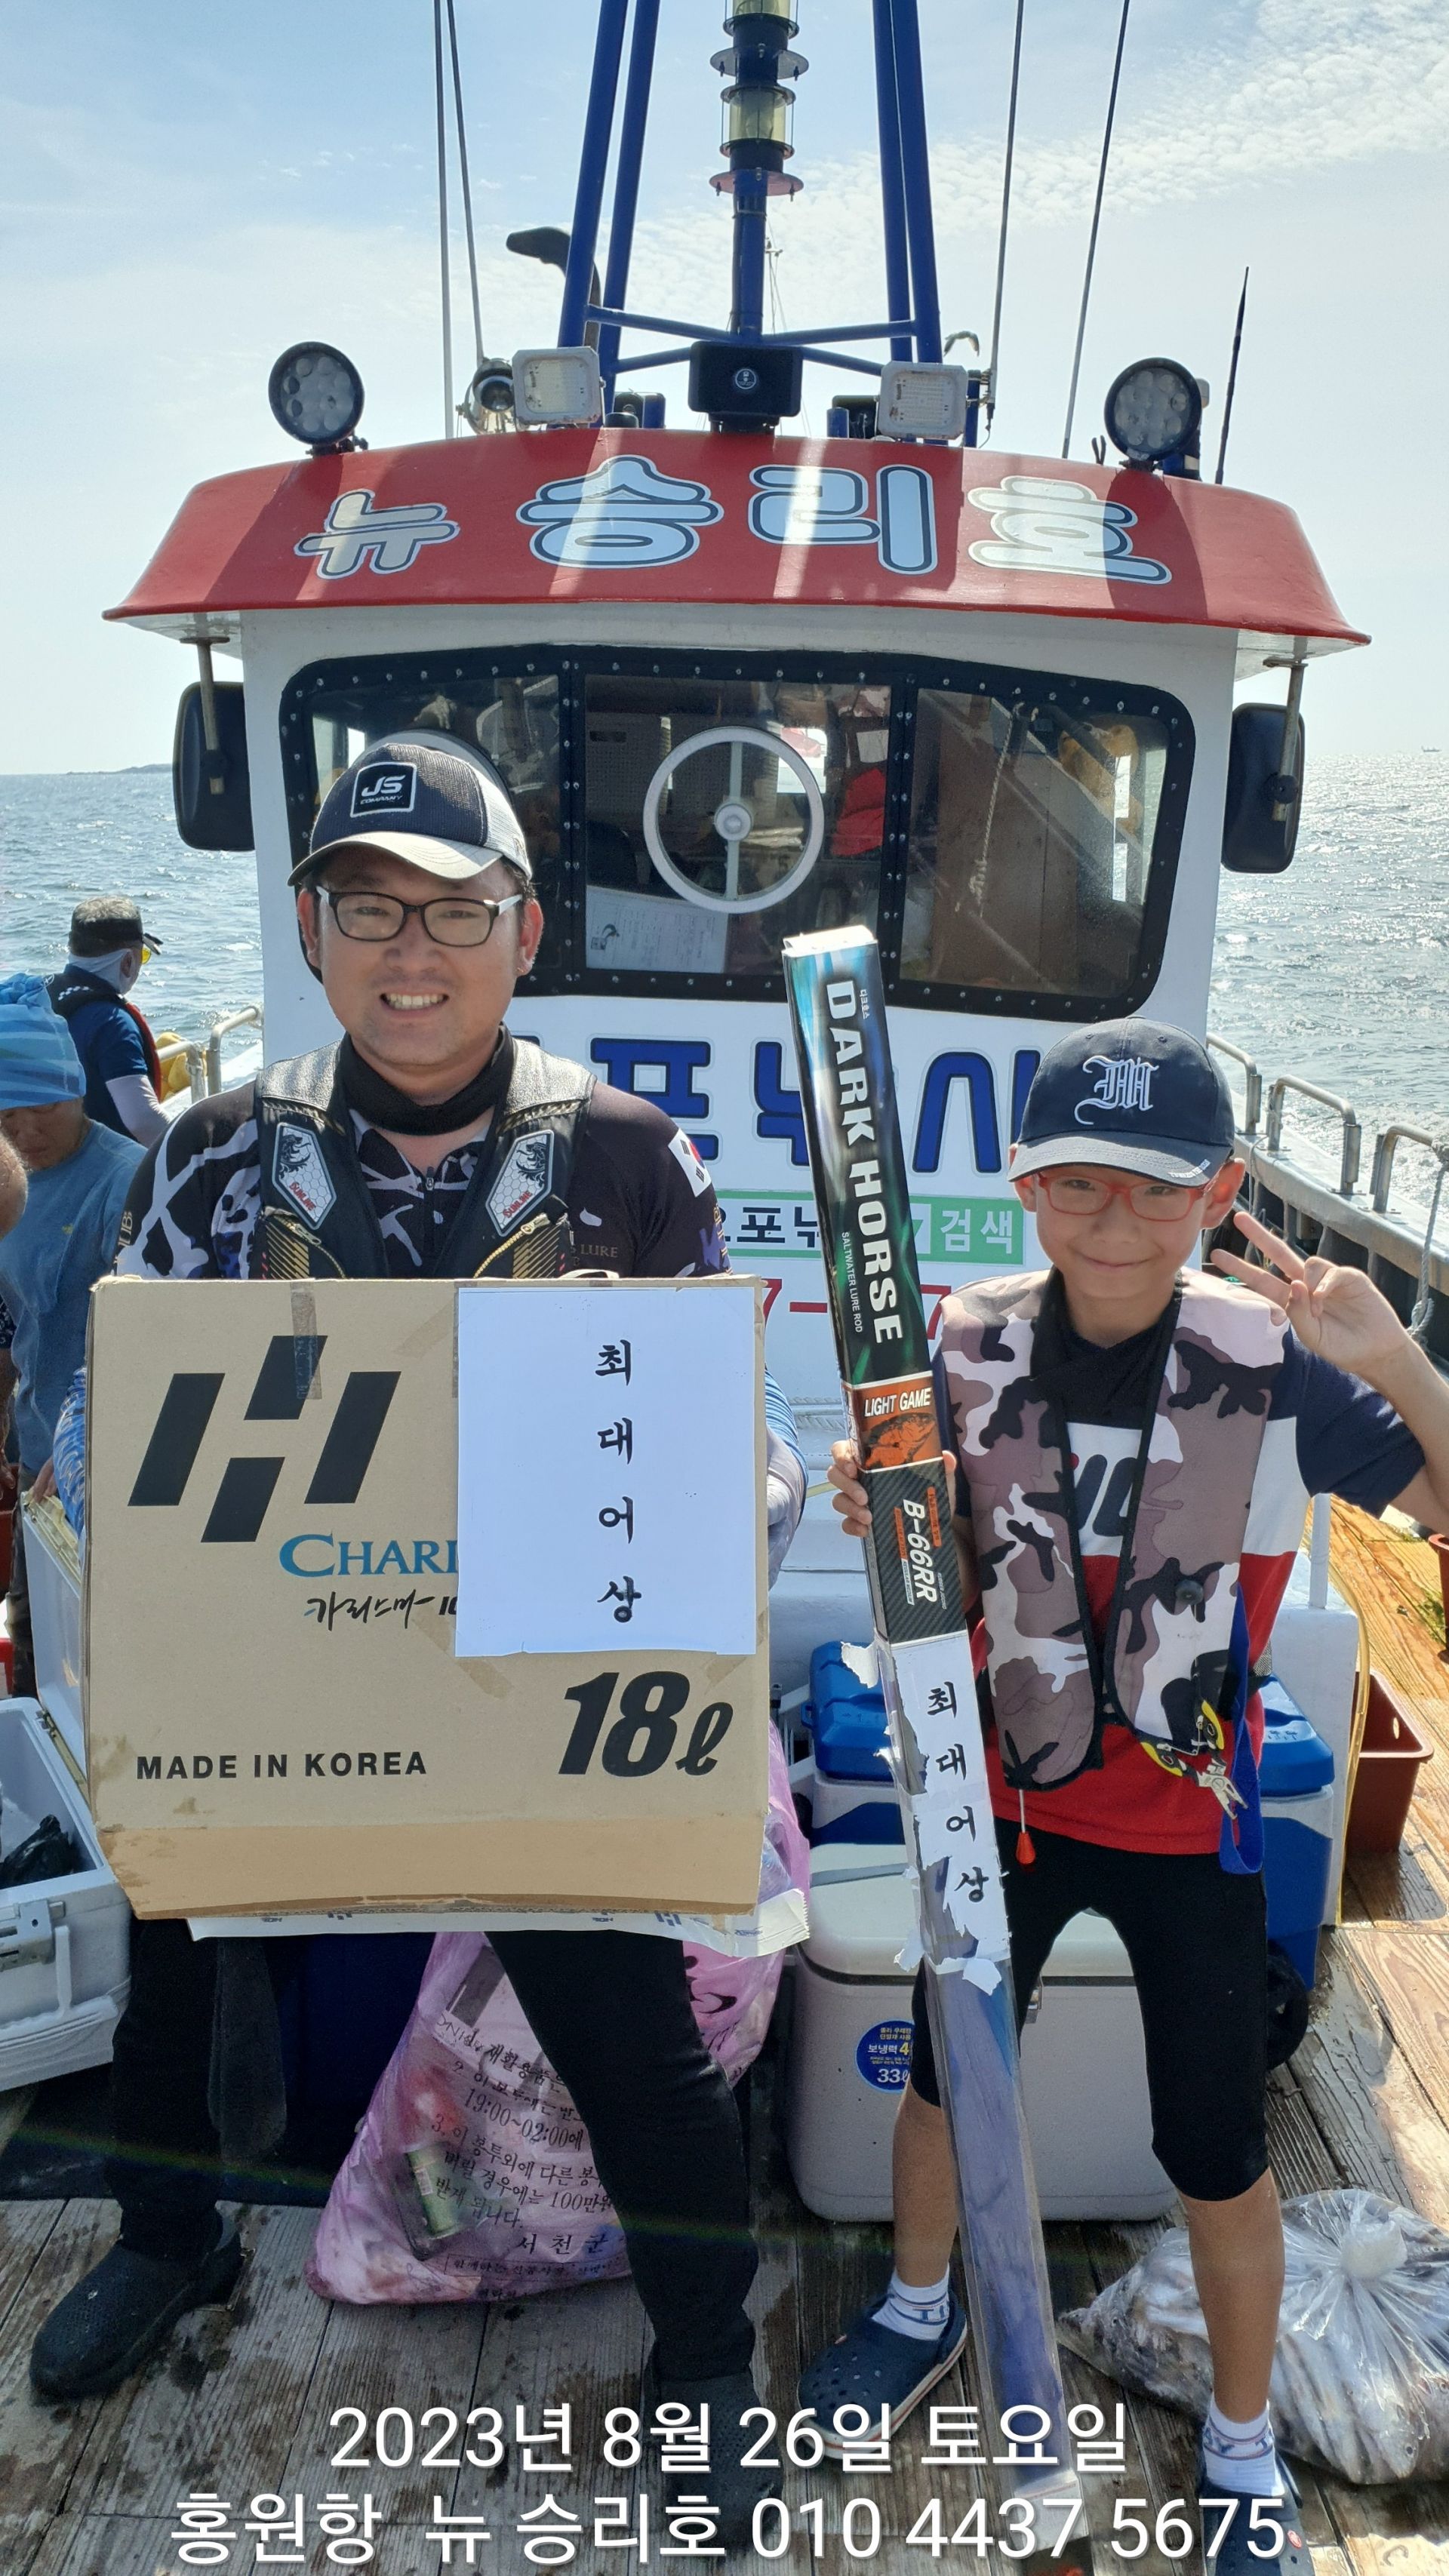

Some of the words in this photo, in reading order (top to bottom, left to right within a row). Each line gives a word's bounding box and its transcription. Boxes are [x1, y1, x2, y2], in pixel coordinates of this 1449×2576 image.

[294, 489, 460, 580] 뉴
[516, 453, 1173, 585] 승리호
[361, 774, 407, 798] JS
[826, 980, 875, 1147] DARK
[580, 1243, 619, 1259] LURE
[940, 1209, 1013, 1255] 검색
[841, 1231, 856, 1286] SALTWATER
[849, 1159, 903, 1345] HORSE
[849, 1287, 860, 1312] LURE
[853, 1313, 863, 1333] ROD
[864, 1394, 897, 1418] LIGHT
[899, 1386, 932, 1412] GAME
[903, 1499, 938, 1603] B-66RR
[137, 1756, 238, 1780] MADE
[255, 1755, 288, 1778] IN
[306, 1751, 427, 1778] KOREA
